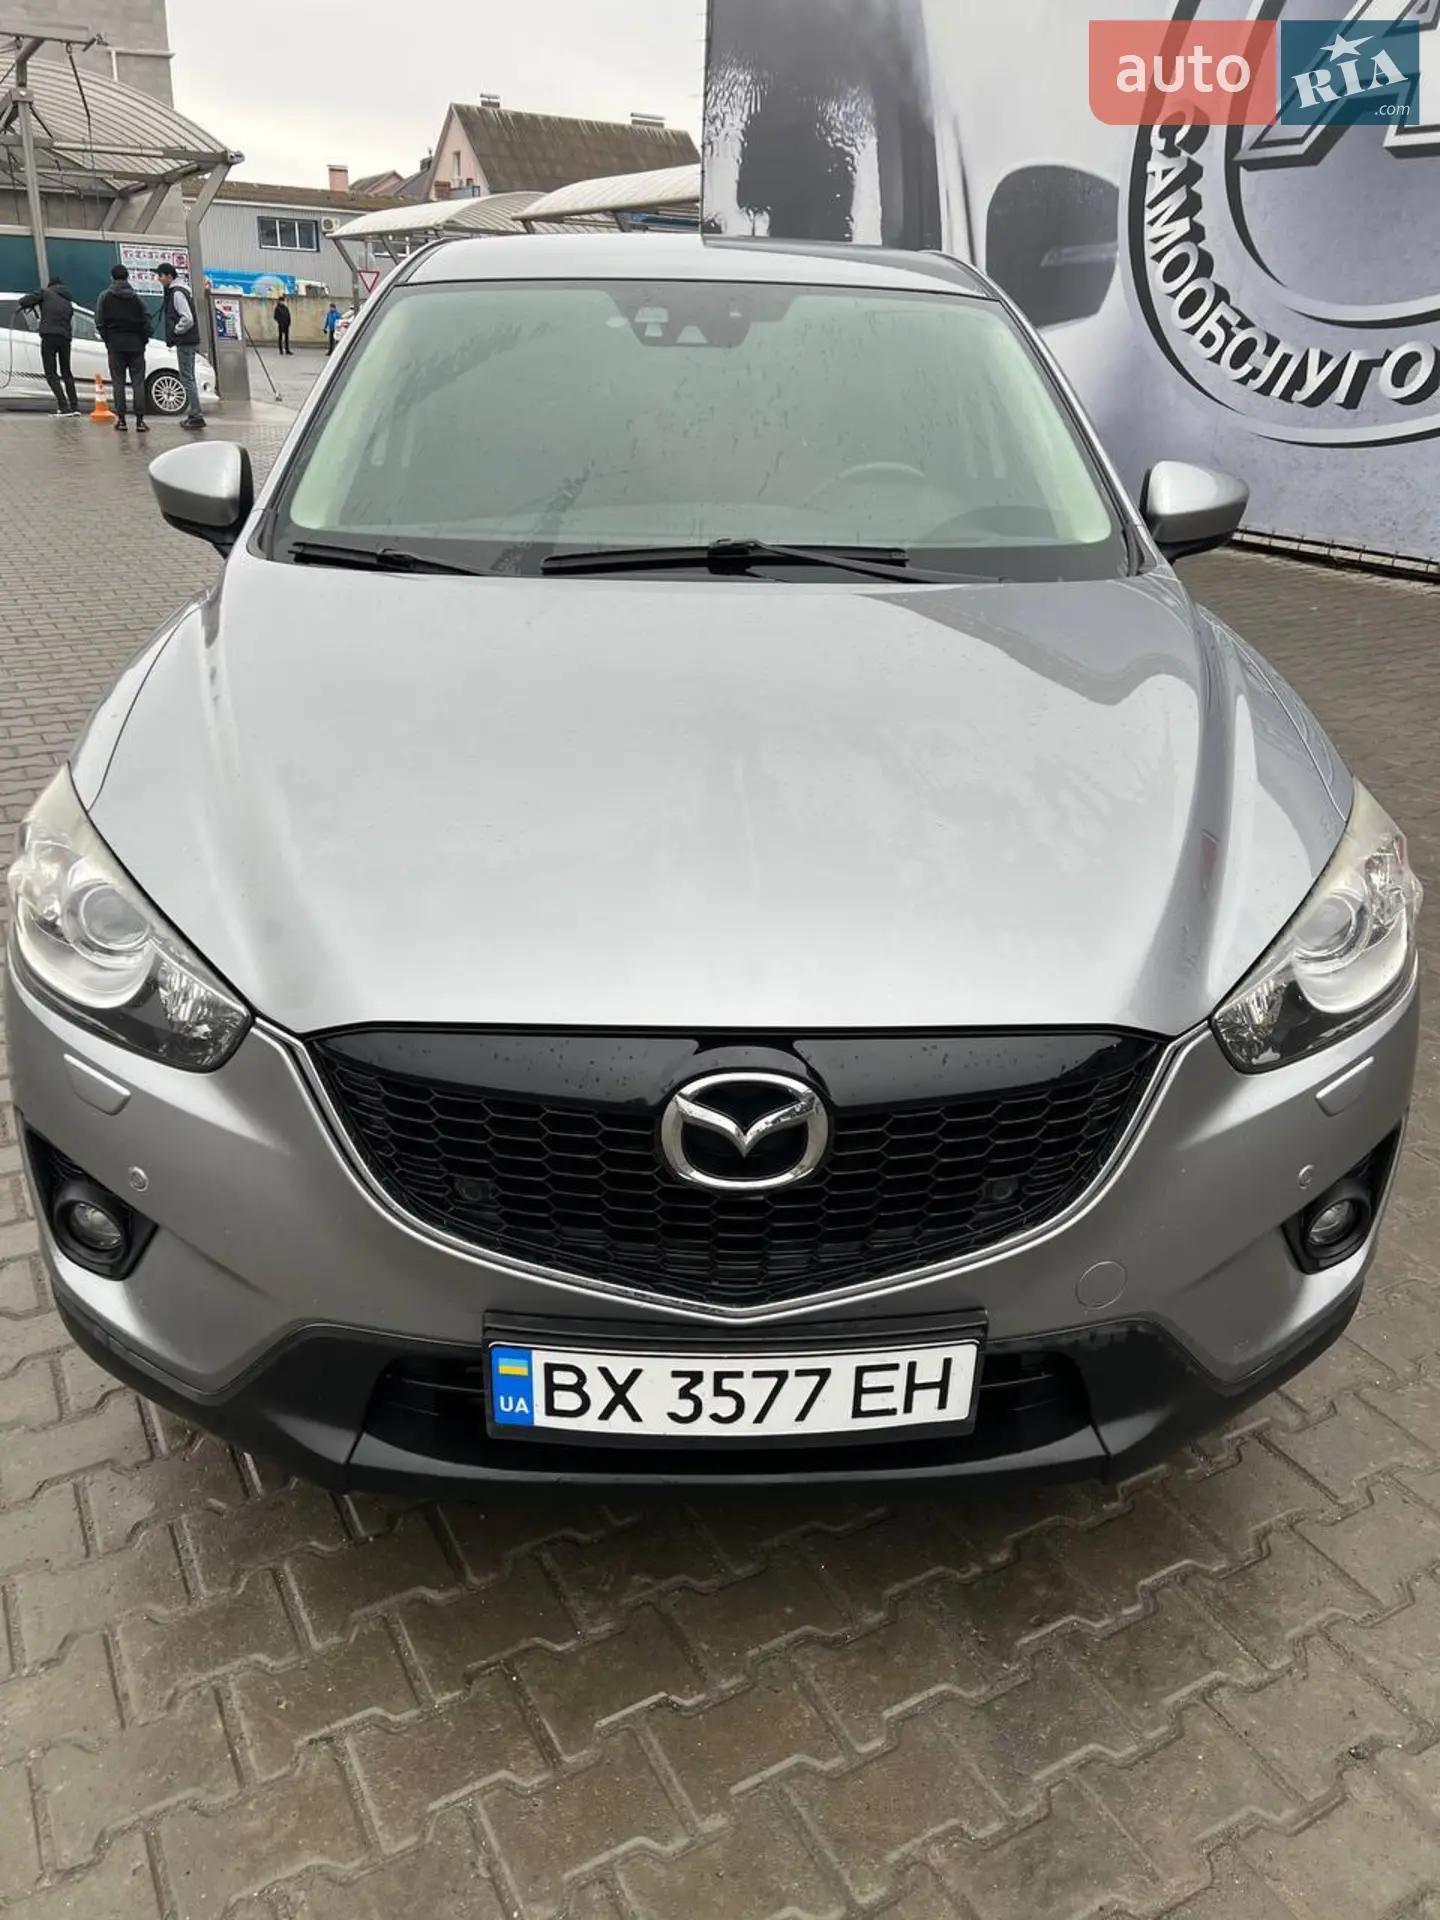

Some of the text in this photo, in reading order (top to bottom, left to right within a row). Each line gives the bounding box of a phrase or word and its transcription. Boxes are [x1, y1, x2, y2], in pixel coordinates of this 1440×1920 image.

[499, 1357, 954, 1425] UA BX 3577 EH
